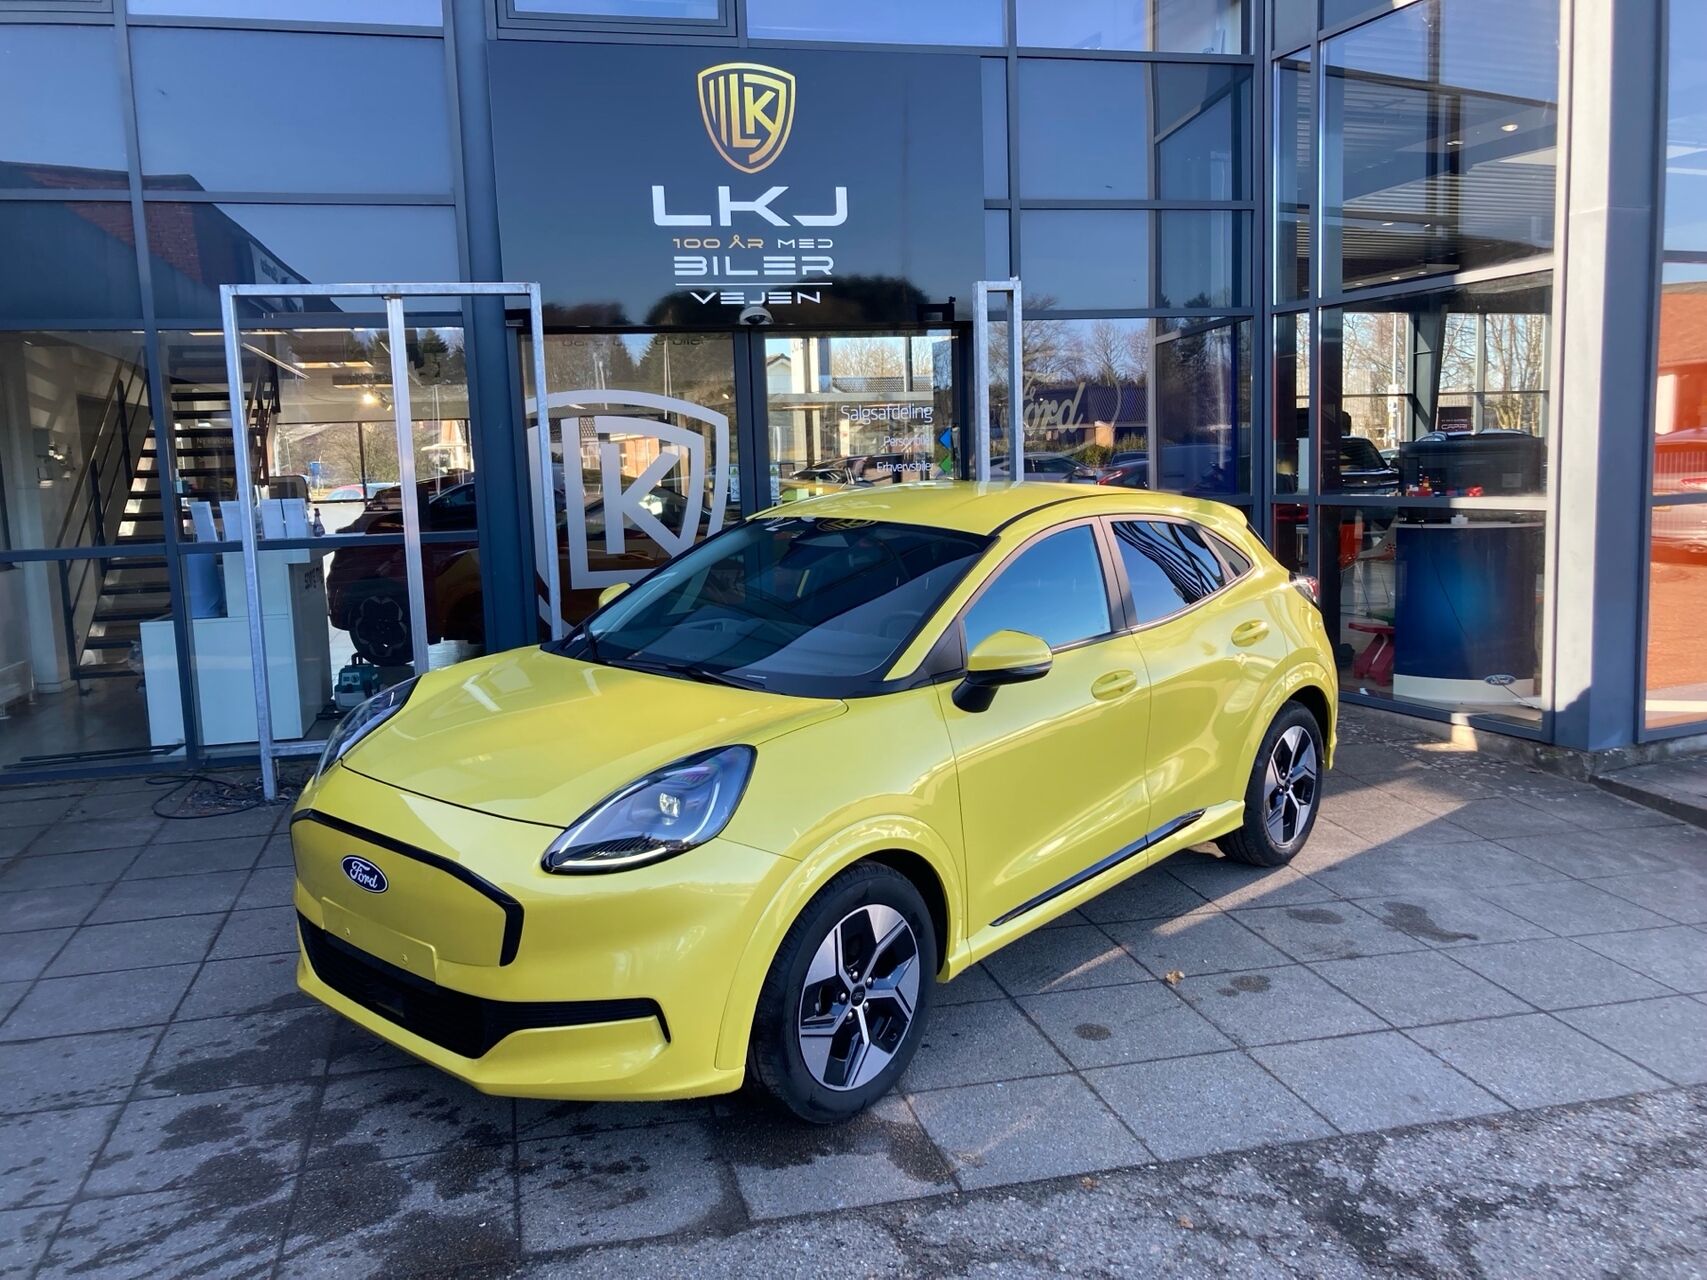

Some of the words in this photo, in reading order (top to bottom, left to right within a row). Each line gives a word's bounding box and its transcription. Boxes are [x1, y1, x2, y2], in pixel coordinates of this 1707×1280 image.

[651, 185, 848, 227] LKJ
[672, 238, 721, 249] 100
[728, 234, 764, 249] ÅR
[777, 238, 834, 249] MED
[673, 256, 834, 276] BILER
[689, 291, 821, 305] VEJEN
[840, 403, 934, 425] Salgsafdeling
[350, 860, 378, 888] Ford
